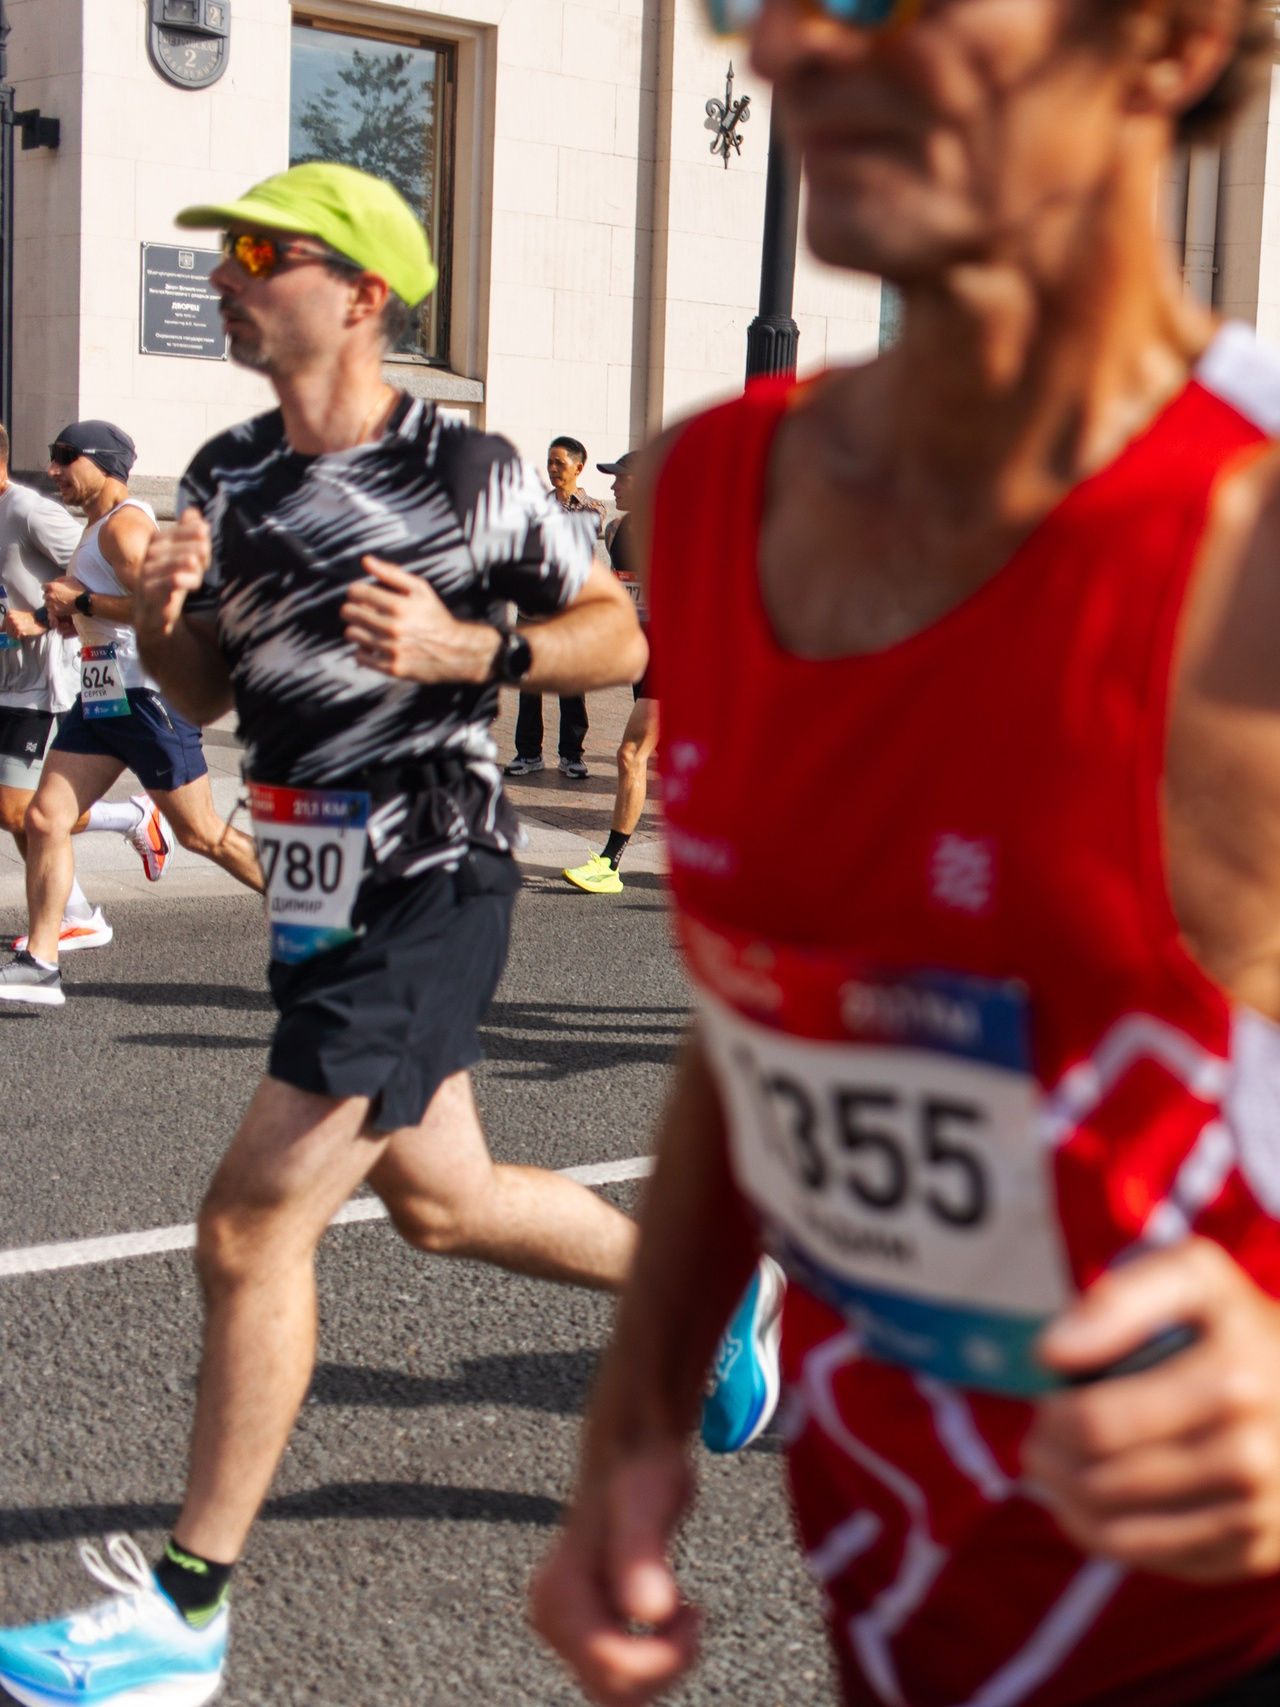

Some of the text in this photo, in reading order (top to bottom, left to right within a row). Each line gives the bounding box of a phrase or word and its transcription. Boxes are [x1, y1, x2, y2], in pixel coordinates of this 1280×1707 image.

[210, 6, 217, 25] 2
[184, 48, 197, 68] 2
[171, 301, 200, 313] ДВОРЕЦ
[82, 666, 114, 689] 624
[84, 689, 108, 698] СЕРГЕЙ
